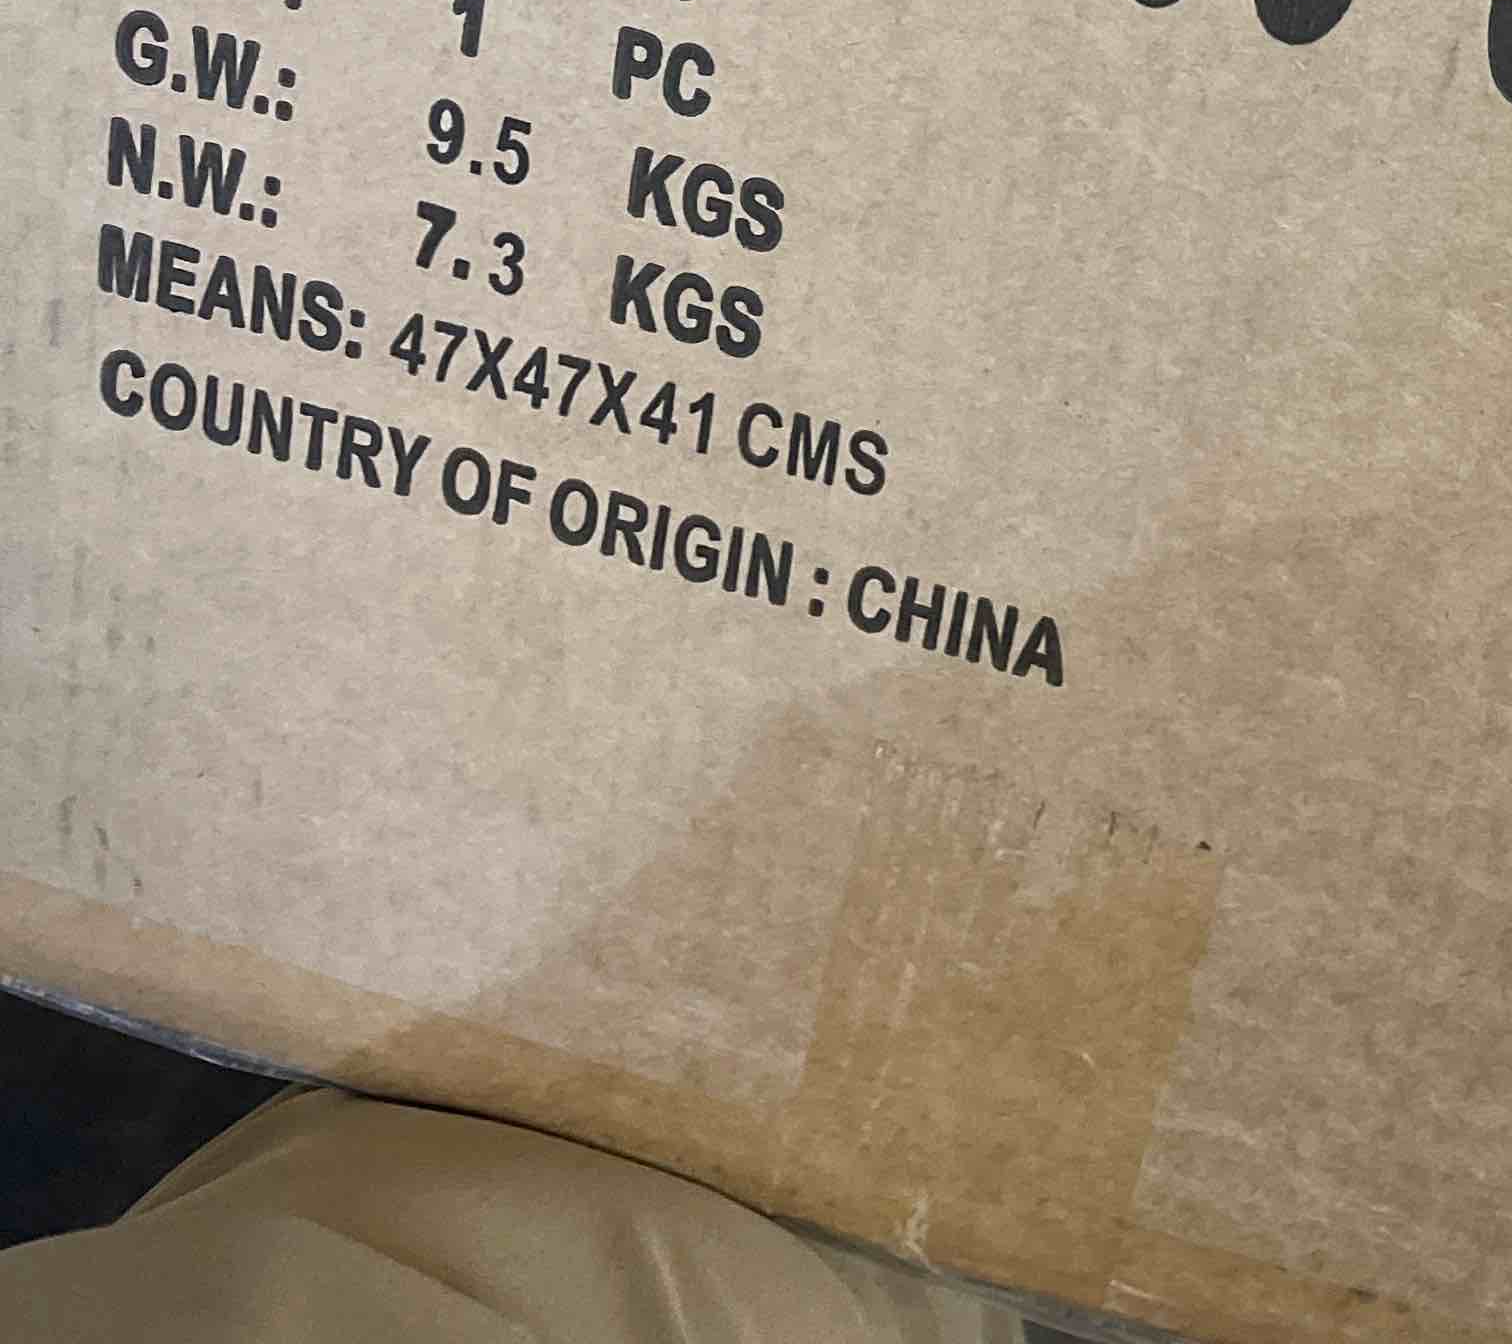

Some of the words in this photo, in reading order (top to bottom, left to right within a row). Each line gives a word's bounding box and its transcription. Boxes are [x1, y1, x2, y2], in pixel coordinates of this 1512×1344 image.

[115, 10, 296, 121] G.W.:
[426, 99, 532, 185] 9.5
[627, 146, 784, 252] KGS
[612, 26, 715, 117] PC
[107, 117, 281, 227] N.W.:
[416, 201, 526, 295] 7.3
[610, 255, 764, 358] KGS
[98, 224, 366, 359] MEANS:
[390, 313, 715, 454] 47X47X41
[738, 403, 888, 496] CMS
[100, 349, 431, 496] COUNTRY
[442, 447, 537, 525] OF
[550, 479, 793, 606] ORIGIN
[847, 566, 1065, 687] CHINA
